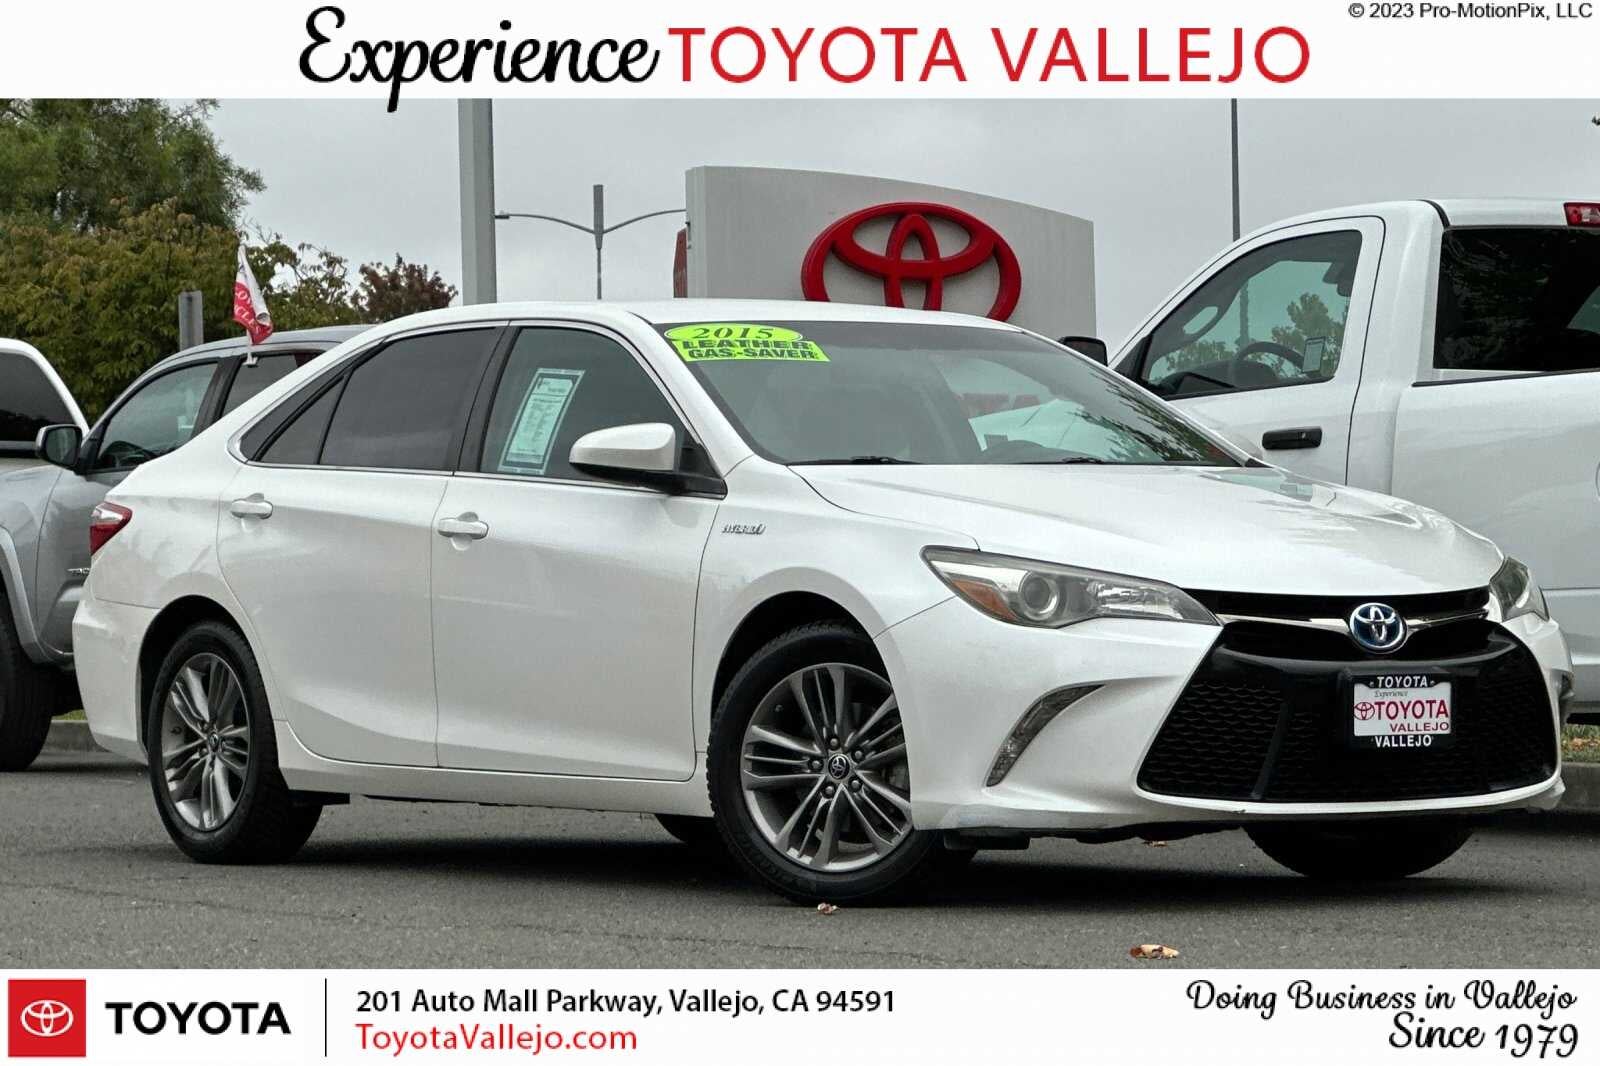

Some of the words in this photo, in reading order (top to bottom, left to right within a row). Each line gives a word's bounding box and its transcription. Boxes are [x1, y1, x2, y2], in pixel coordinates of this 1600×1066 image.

[693, 327, 774, 339] 2015
[682, 338, 811, 350] LEATHER
[1377, 675, 1428, 688] TOYOTA
[1374, 699, 1449, 720] TOYOTA
[1390, 721, 1450, 732] VALLEJO
[1374, 735, 1432, 747] VALLEJO
